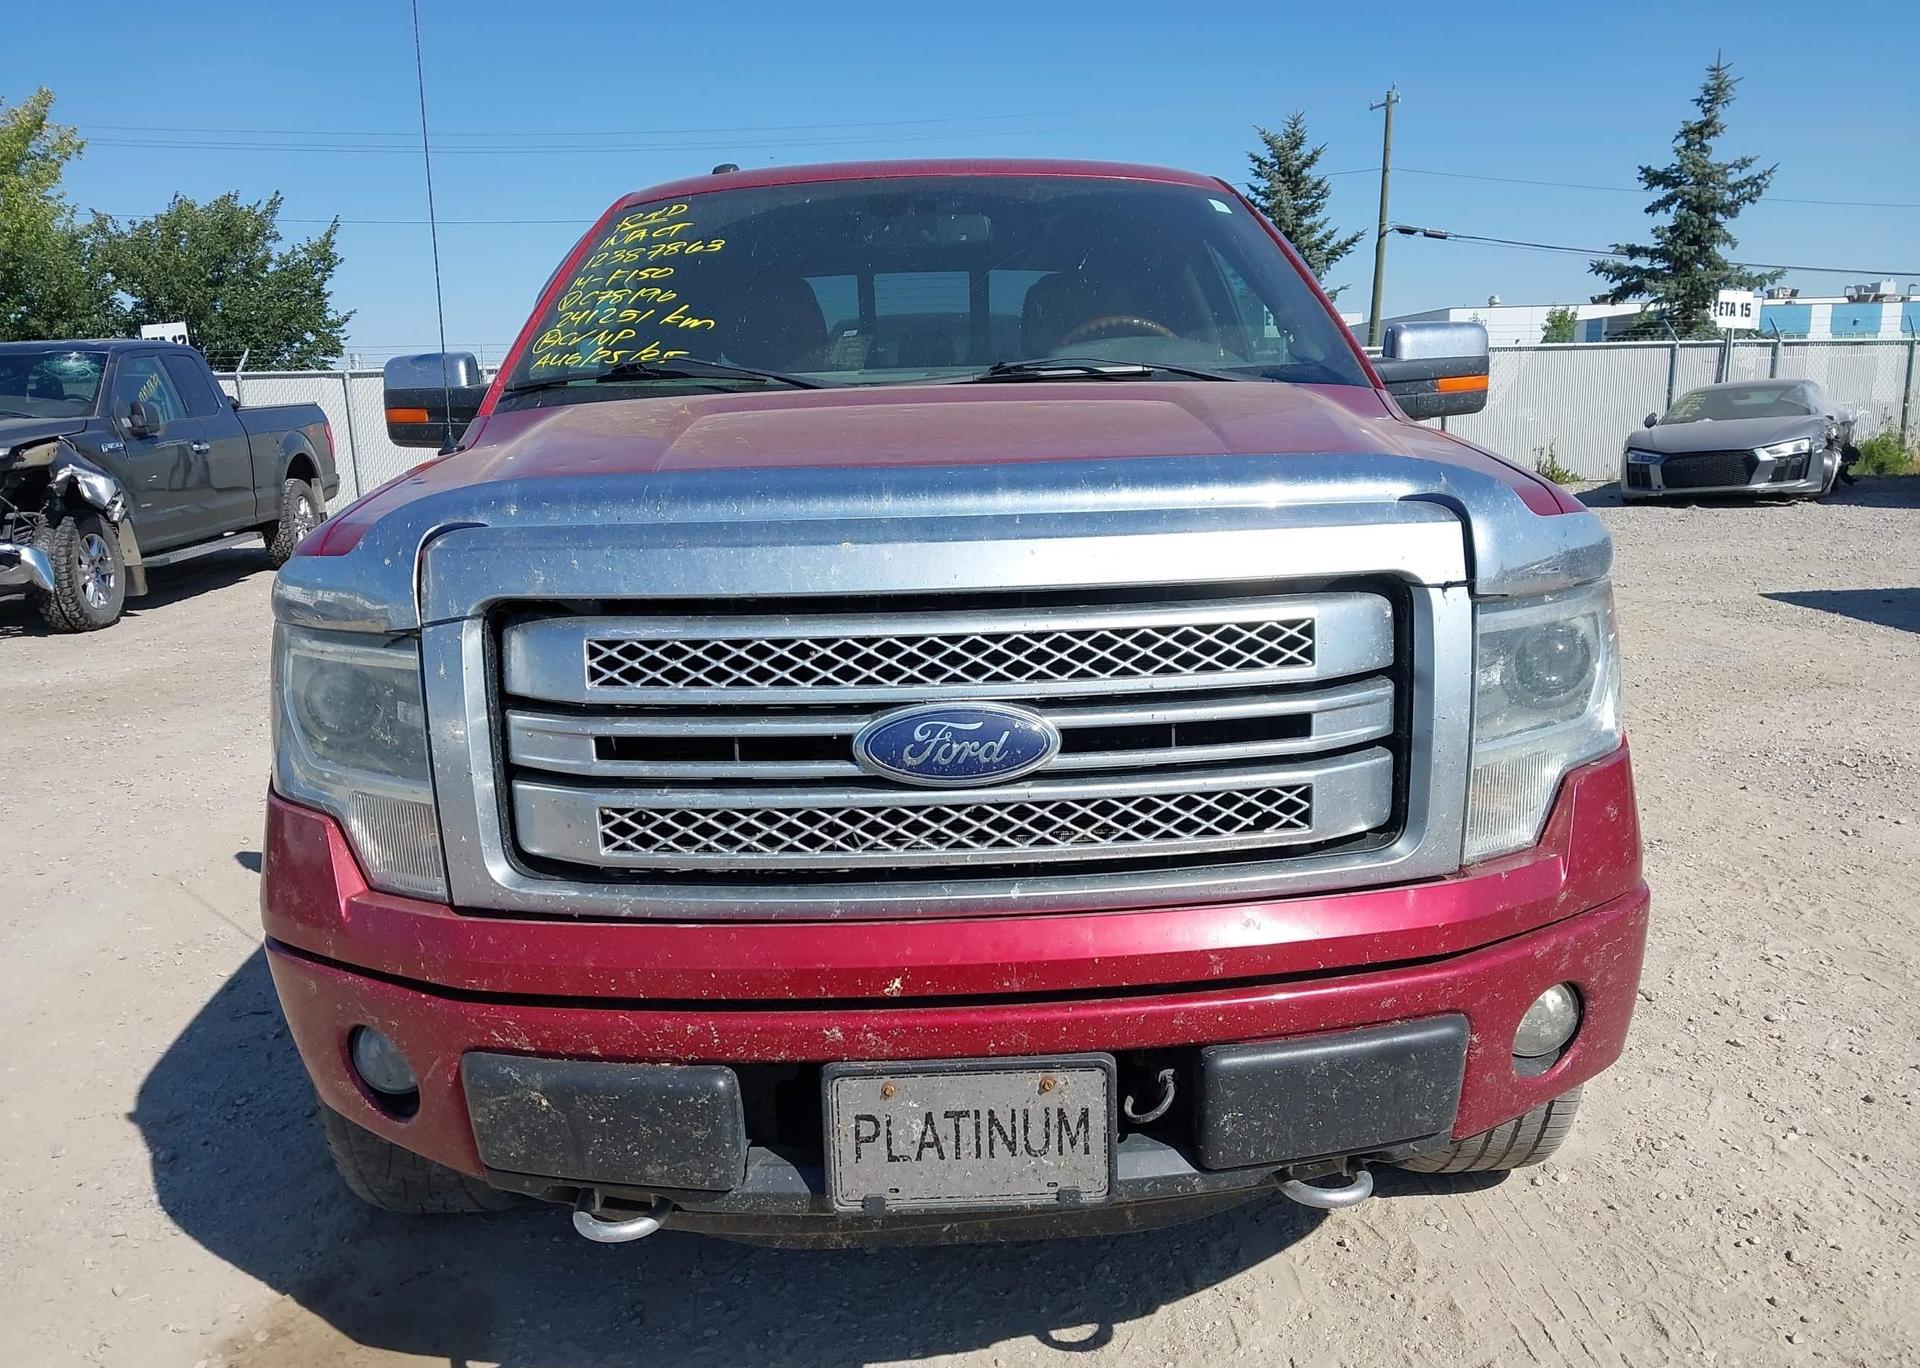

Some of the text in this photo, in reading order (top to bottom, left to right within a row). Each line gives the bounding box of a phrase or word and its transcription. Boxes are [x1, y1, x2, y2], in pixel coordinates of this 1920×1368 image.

[582, 239, 726, 272] 12387863
[556, 304, 715, 330] 241251 km
[1740, 302, 1752, 318] 15
[903, 721, 1011, 766] Ford
[854, 1106, 1091, 1164] PLATINUM
